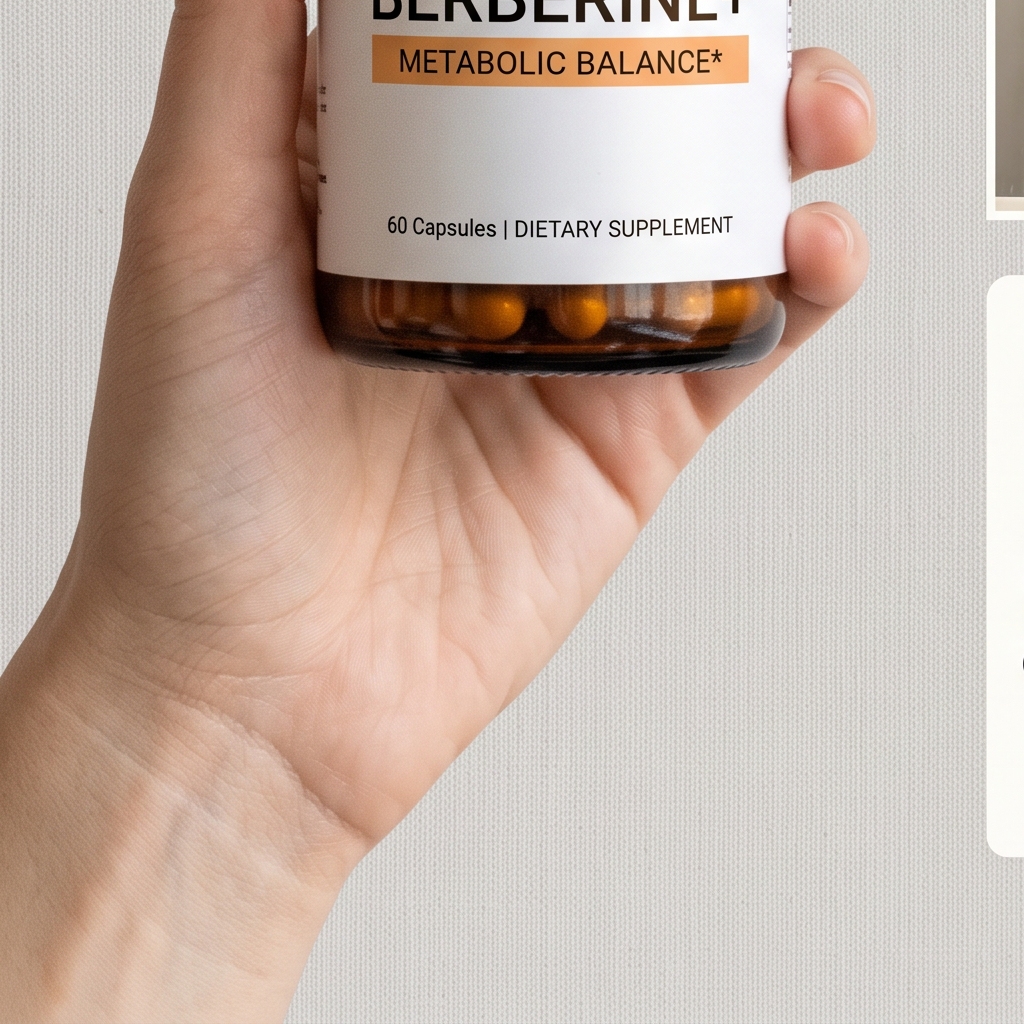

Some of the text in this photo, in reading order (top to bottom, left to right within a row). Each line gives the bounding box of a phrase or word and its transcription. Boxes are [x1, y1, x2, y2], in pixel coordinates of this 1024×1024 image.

[399, 48, 567, 76] METABOLIC
[387, 215, 408, 235] 60
[412, 216, 497, 241] Capsules
[515, 219, 603, 238] DIETARY
[608, 215, 733, 238] SUPPLEMENT
